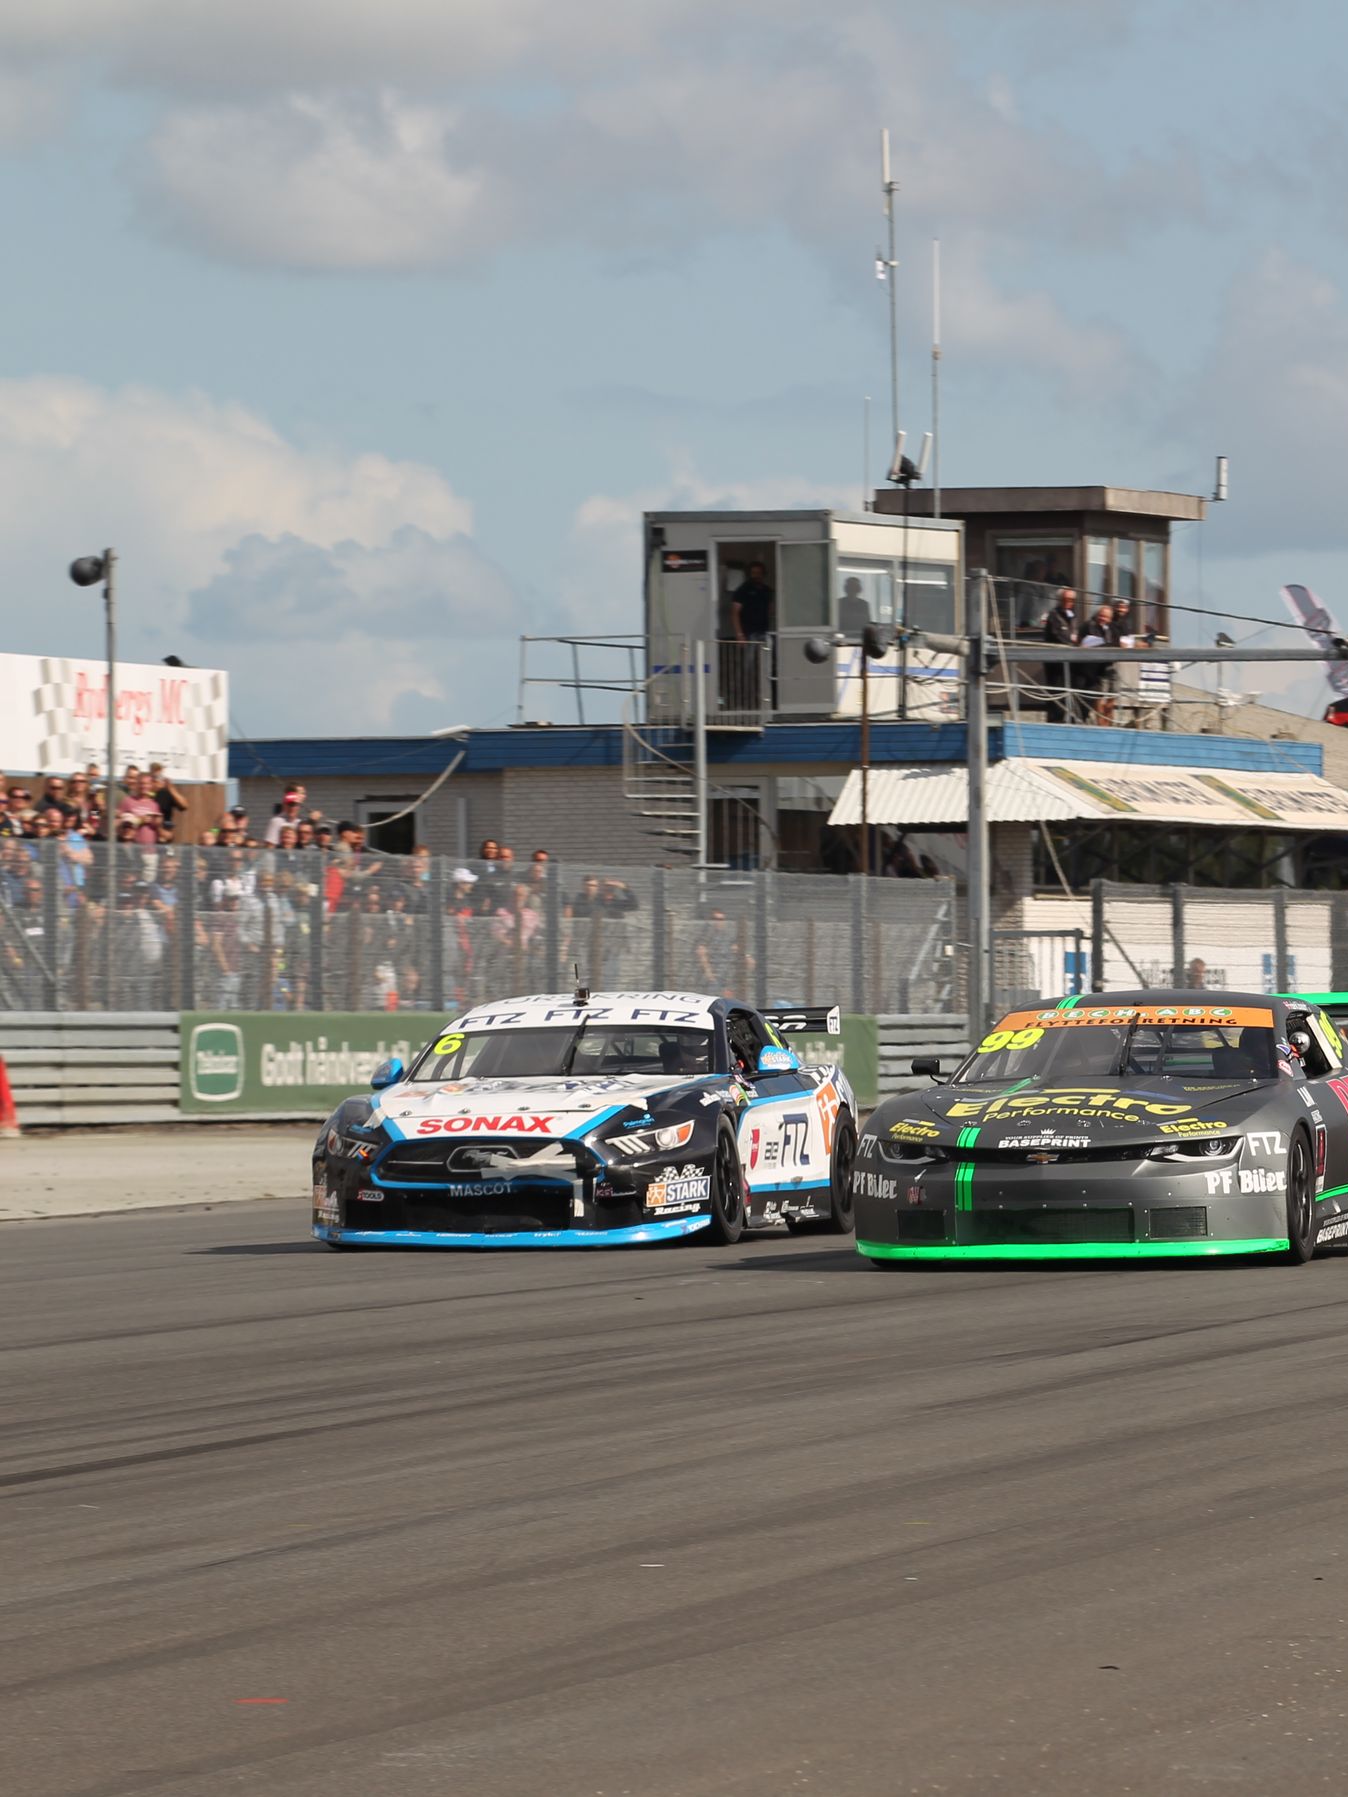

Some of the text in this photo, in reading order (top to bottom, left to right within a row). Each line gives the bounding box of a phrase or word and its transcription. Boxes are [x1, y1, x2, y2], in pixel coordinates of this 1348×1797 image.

[458, 1007, 701, 1030] FTZ FTZ FTZ
[433, 1032, 466, 1056] 6
[977, 1027, 1046, 1054] 99
[946, 1092, 1193, 1118] Electro
[982, 1105, 1141, 1124] Performance
[415, 1116, 555, 1136] SONAX
[888, 1121, 941, 1139] Electro
[1159, 1118, 1229, 1135] Electro
[998, 1138, 1092, 1150] BASEPRINT
[1246, 1131, 1289, 1158] FTZ
[449, 1182, 514, 1199] MASCOT
[667, 1179, 707, 1201] STARK
[1204, 1168, 1288, 1195] PF Biler
